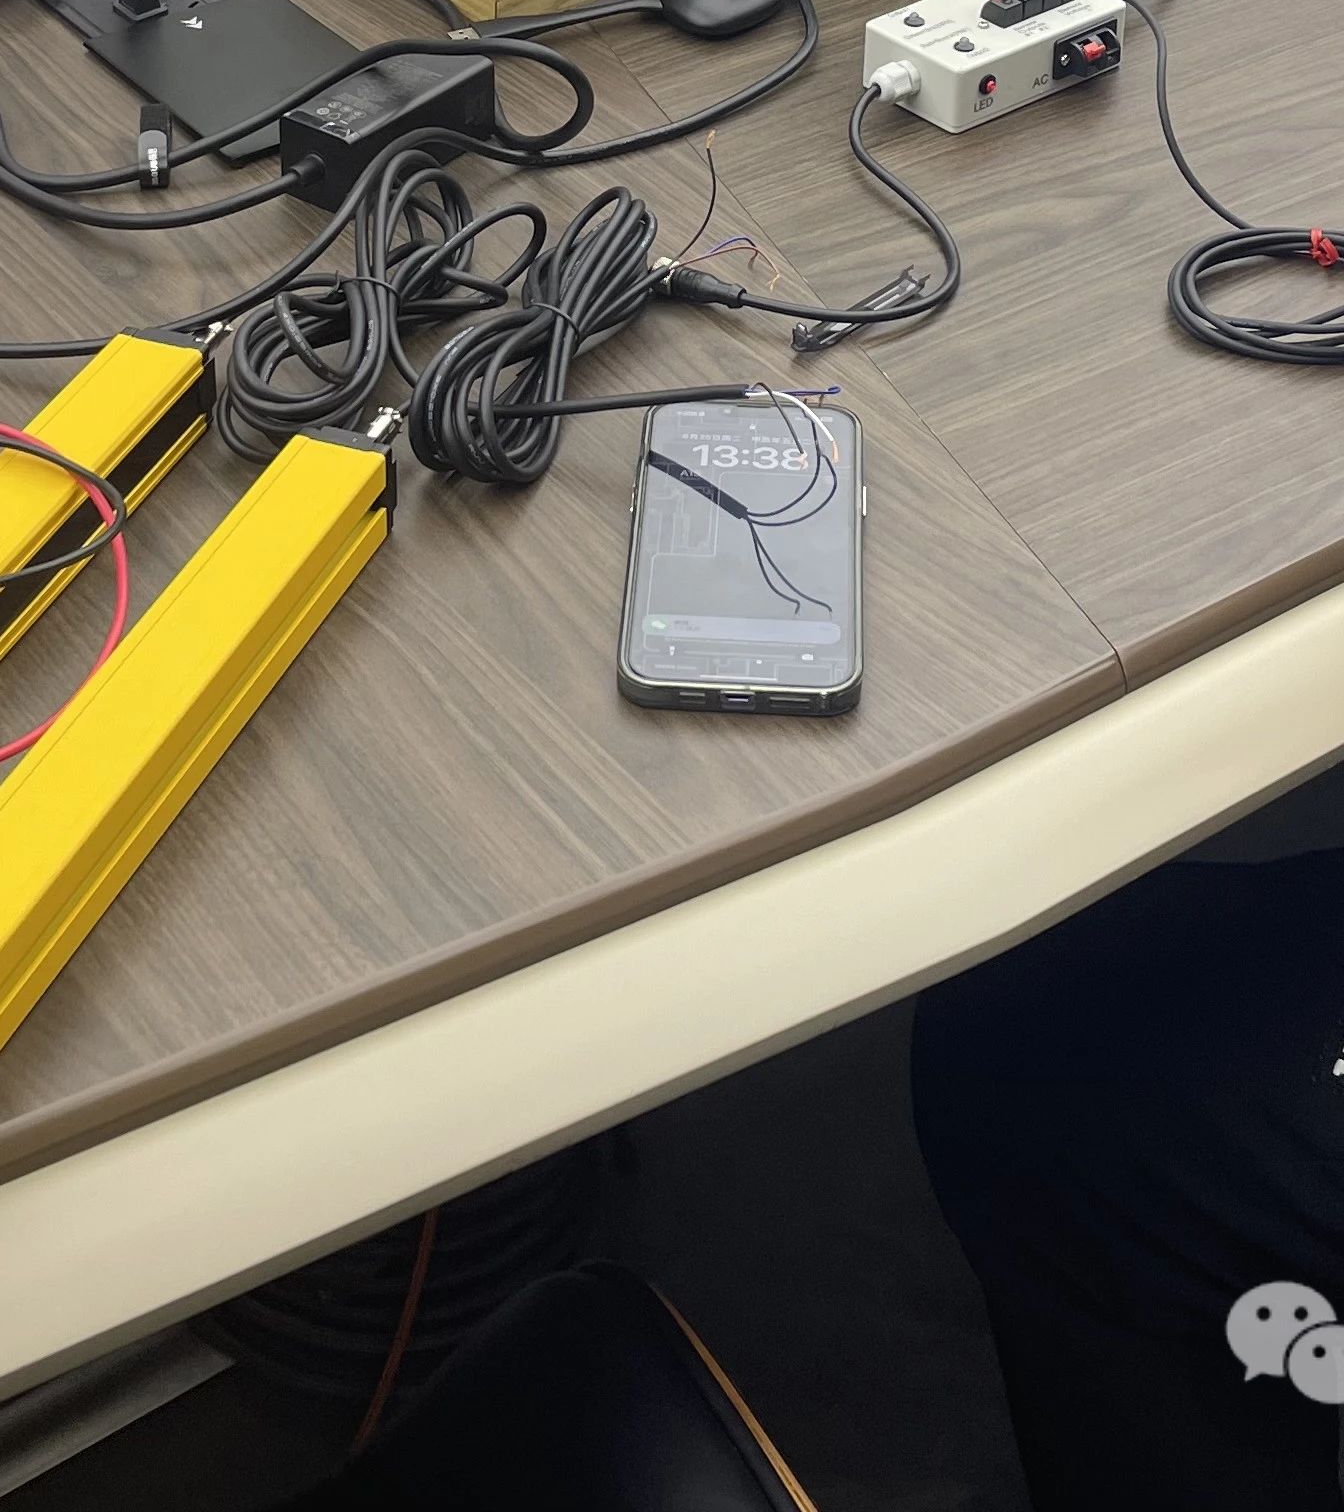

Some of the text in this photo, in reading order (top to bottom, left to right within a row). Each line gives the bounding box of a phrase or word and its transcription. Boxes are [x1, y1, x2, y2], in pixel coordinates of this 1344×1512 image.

[1032, 73, 1050, 89] AC
[973, 96, 994, 113] LED
[692, 444, 809, 471] 13:38
